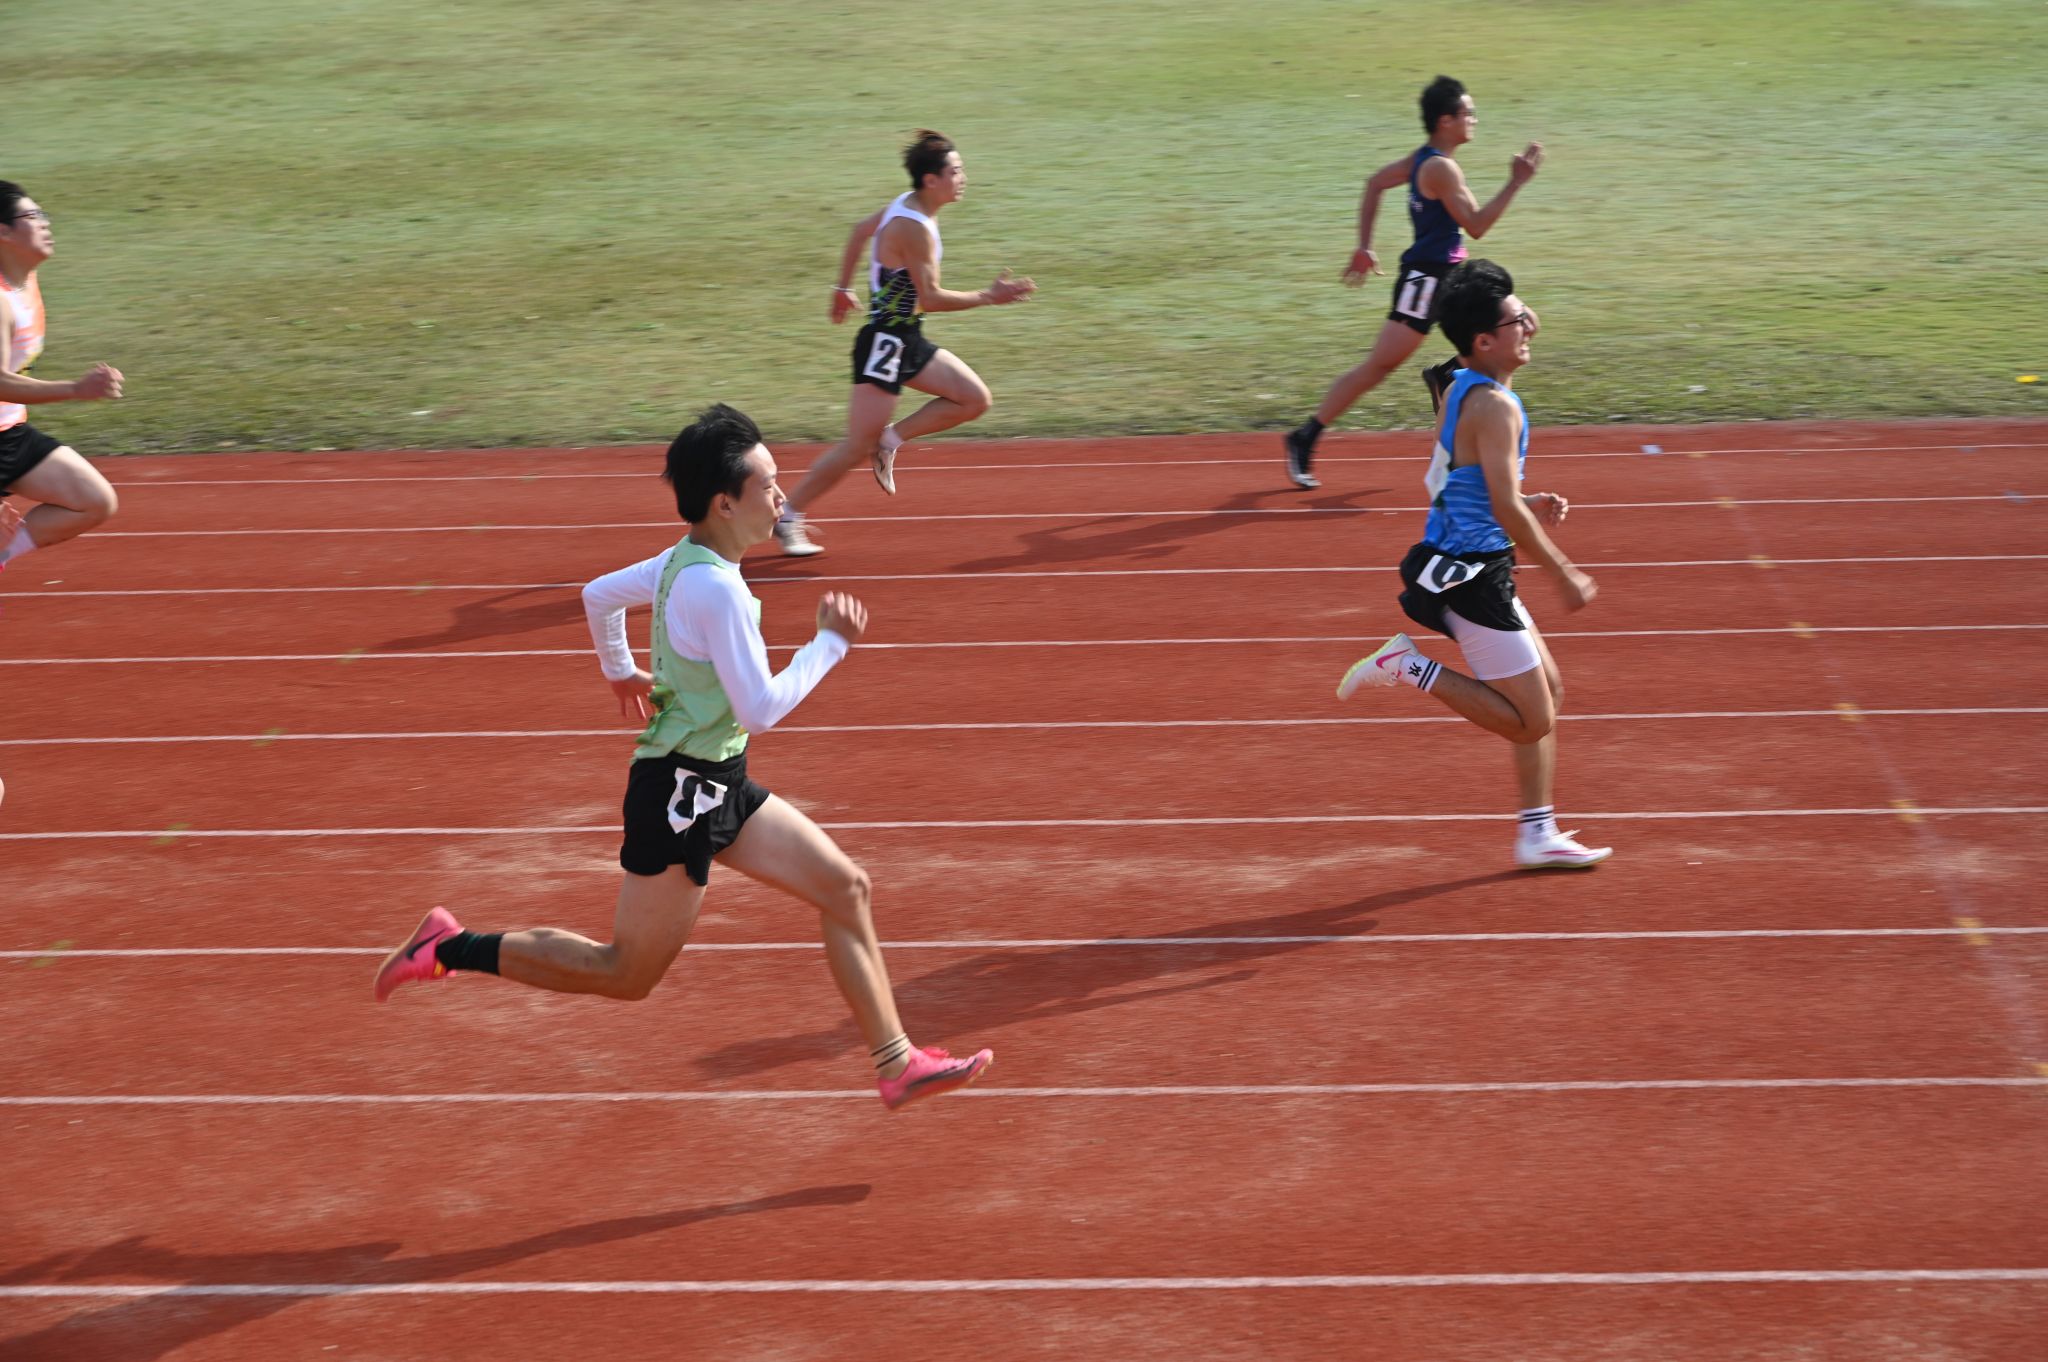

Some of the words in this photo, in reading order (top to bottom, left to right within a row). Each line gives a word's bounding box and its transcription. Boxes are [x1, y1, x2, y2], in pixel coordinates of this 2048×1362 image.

[1408, 279, 1427, 312] 1
[870, 338, 898, 376] 2
[1432, 555, 1468, 590] 6
